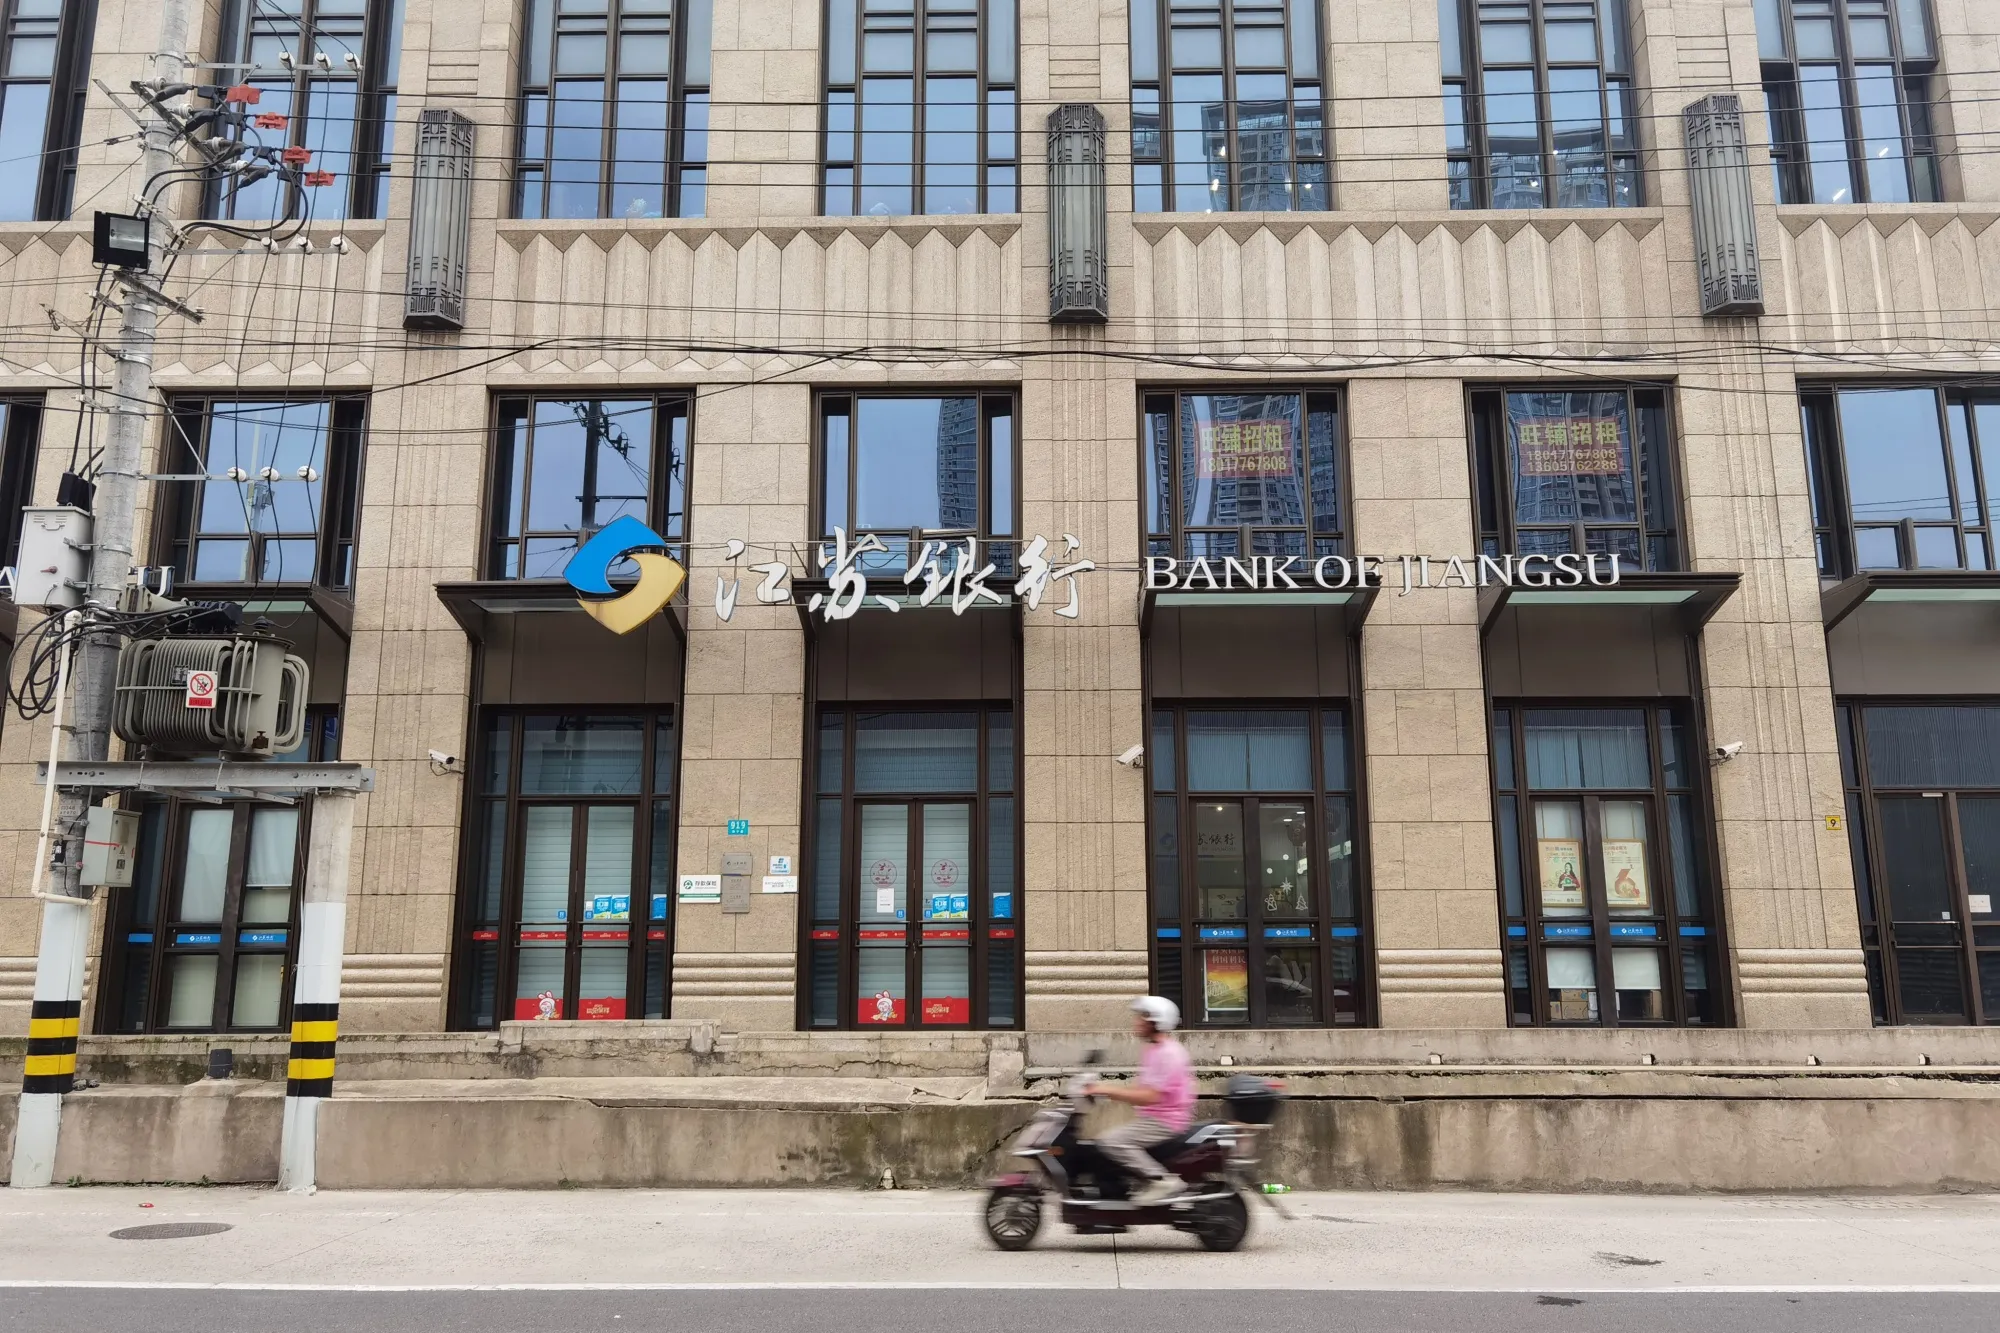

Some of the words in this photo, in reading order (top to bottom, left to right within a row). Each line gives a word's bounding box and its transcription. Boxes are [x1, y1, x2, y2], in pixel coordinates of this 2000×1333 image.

[1201, 424, 1284, 453] 旺铺招租
[1520, 422, 1620, 446] 旺铺招租
[1527, 448, 1617, 461] 18017767808
[1202, 455, 1287, 473] 18017767808
[1528, 460, 1618, 472] 13605762286
[716, 525, 1097, 623] 江苏银行
[1145, 555, 1302, 590] BANK
[1314, 554, 1385, 589] OF
[1400, 553, 1622, 597] JIANGSU
[730, 820, 746, 830] 919
[1830, 818, 1837, 828] 9
